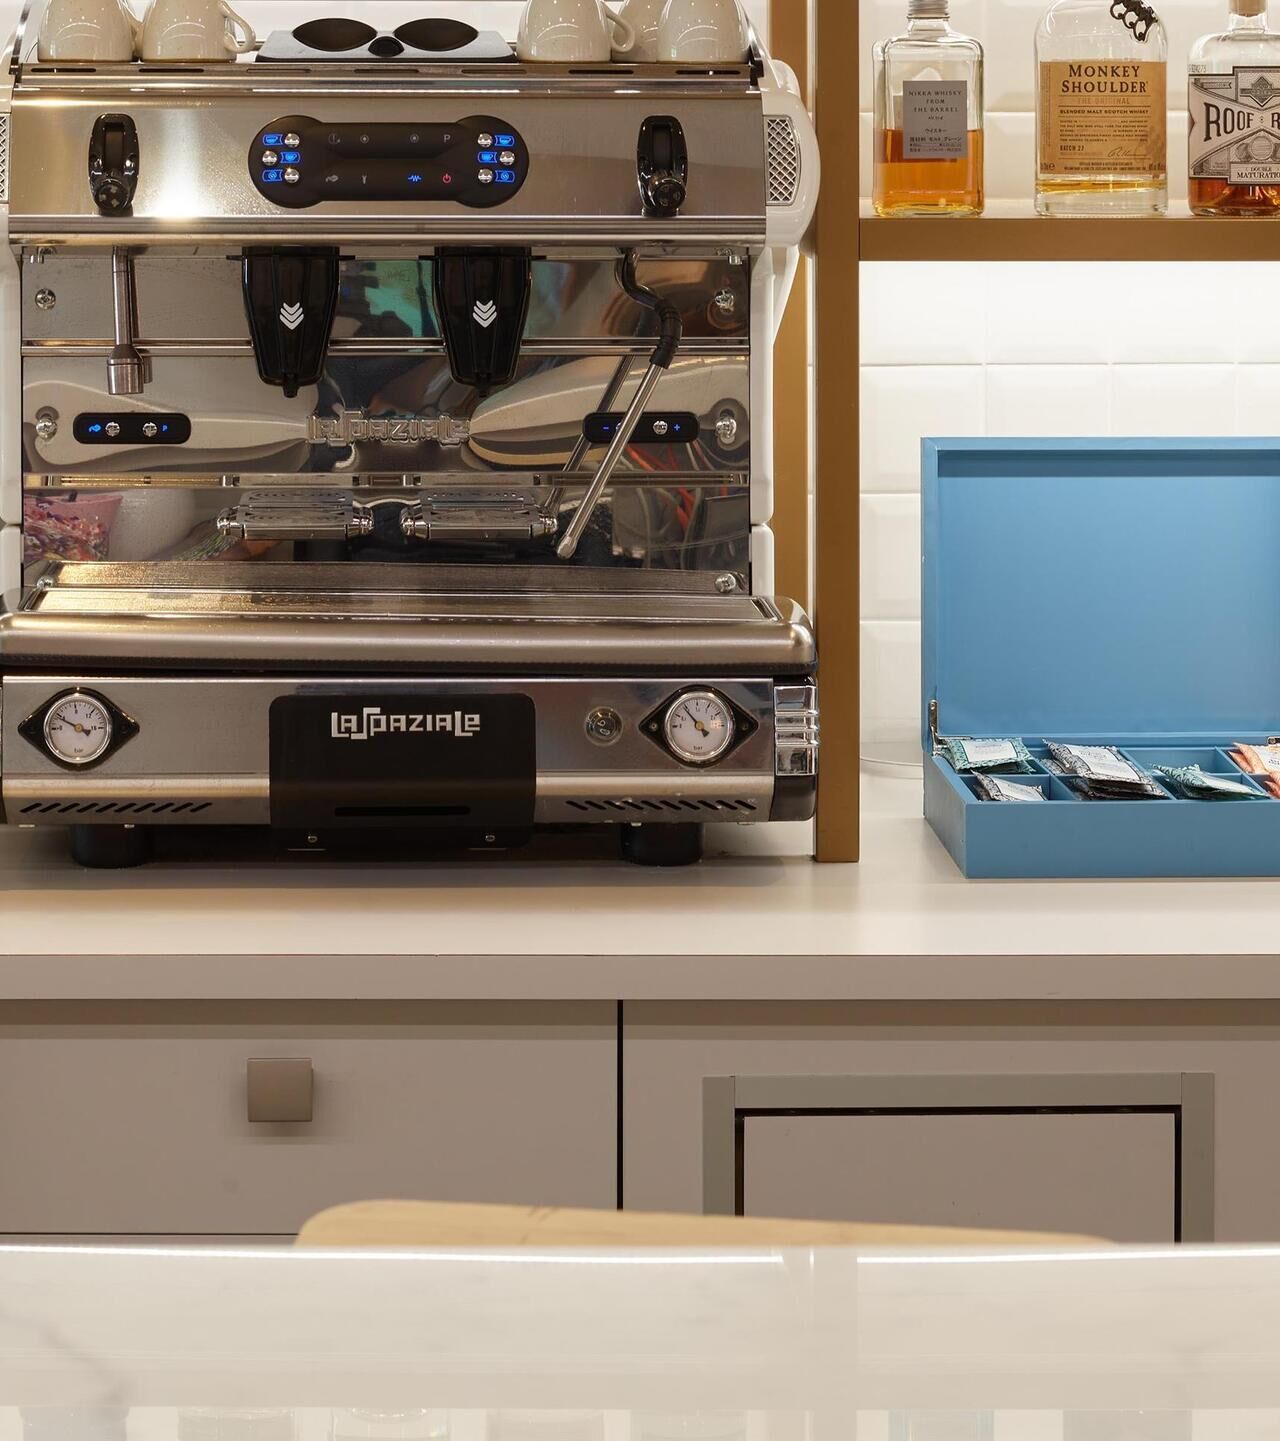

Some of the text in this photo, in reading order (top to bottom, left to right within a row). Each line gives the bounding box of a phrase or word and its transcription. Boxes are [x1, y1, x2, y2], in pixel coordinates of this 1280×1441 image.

[1068, 63, 1141, 78] MONKEY
[1061, 79, 1146, 93] SHOULDER
[925, 98, 945, 106] FROM
[929, 106, 960, 114] BARREL
[1203, 101, 1255, 142] ROOF
